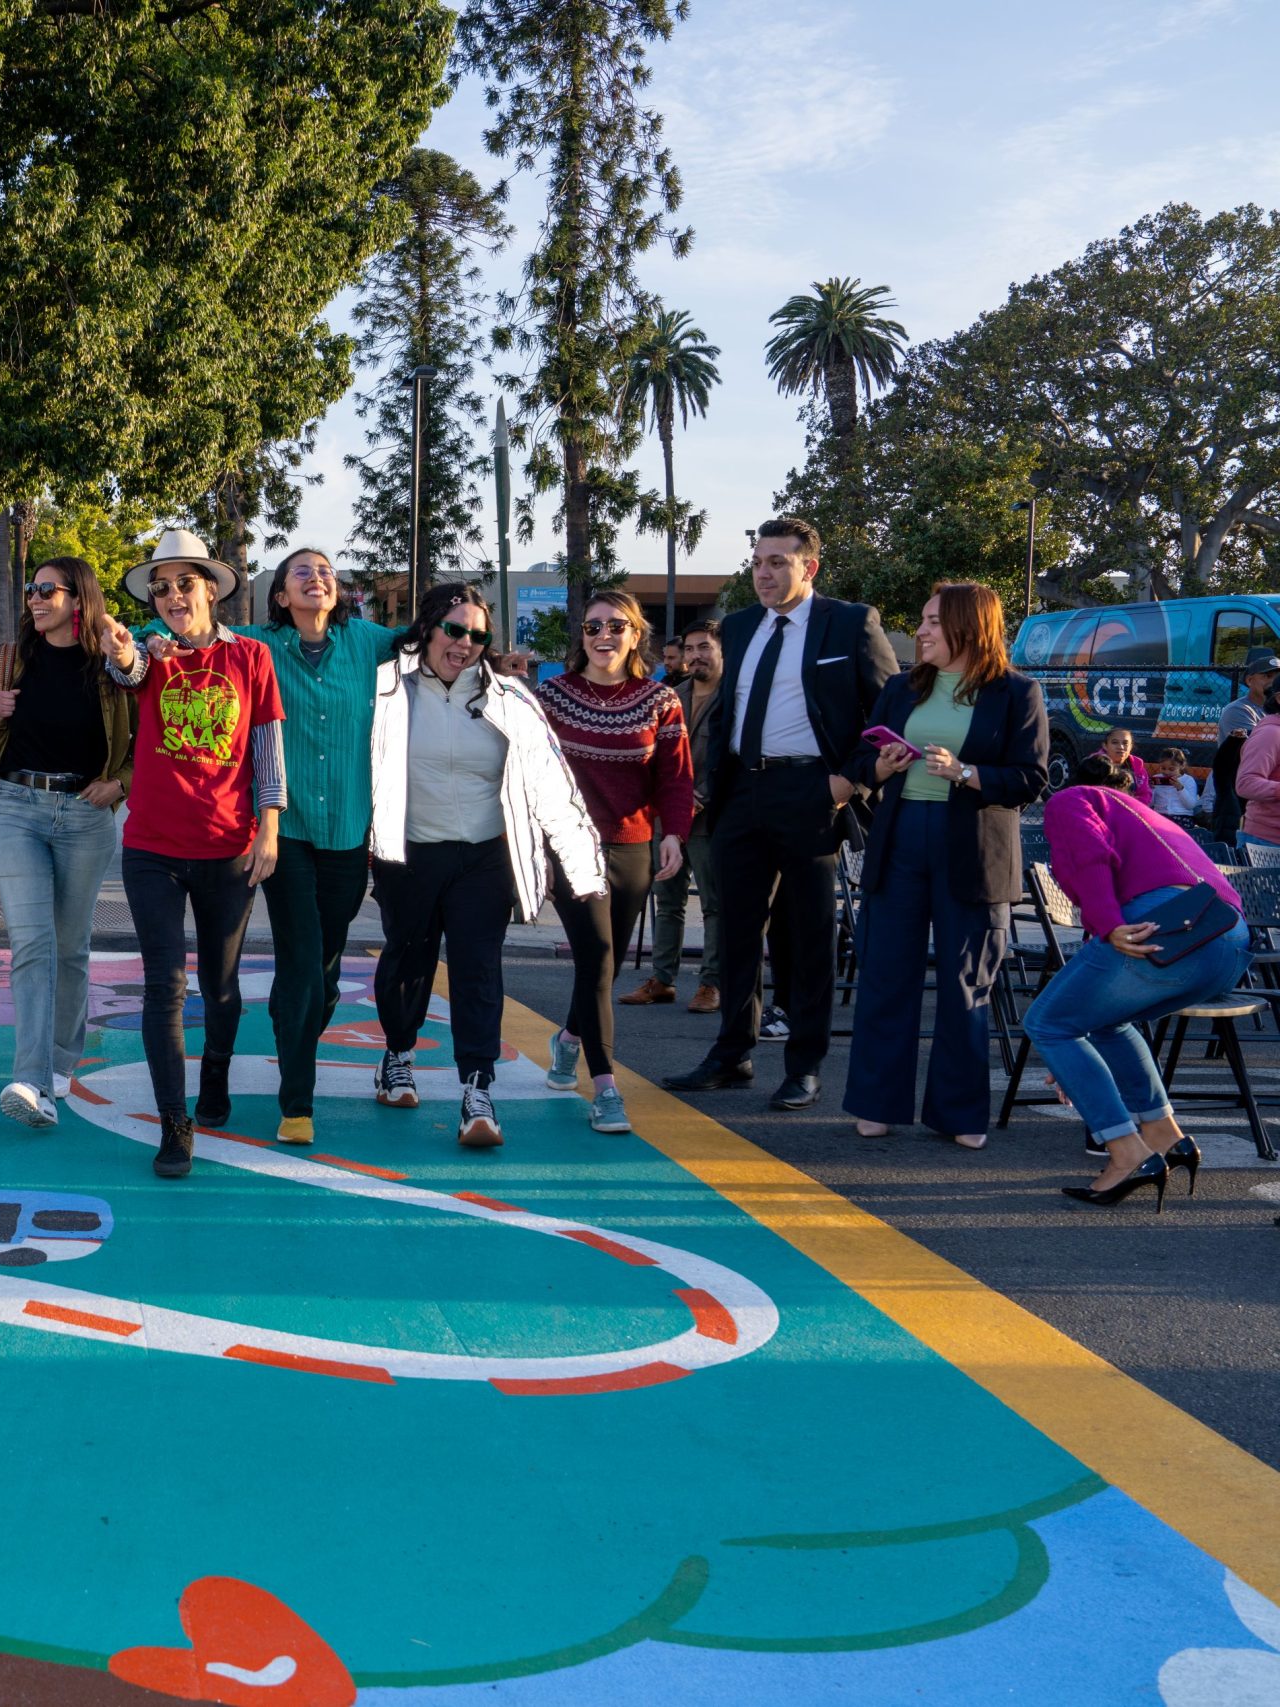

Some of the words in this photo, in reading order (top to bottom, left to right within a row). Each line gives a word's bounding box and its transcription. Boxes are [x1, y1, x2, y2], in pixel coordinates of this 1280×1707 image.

[1092, 677, 1148, 716] CTE
[155, 747, 172, 757] SANTA
[175, 753, 188, 761] ANA
[191, 756, 213, 765] ACTIVE
[216, 759, 239, 768] STREETS
[163, 724, 232, 759] SAAS
